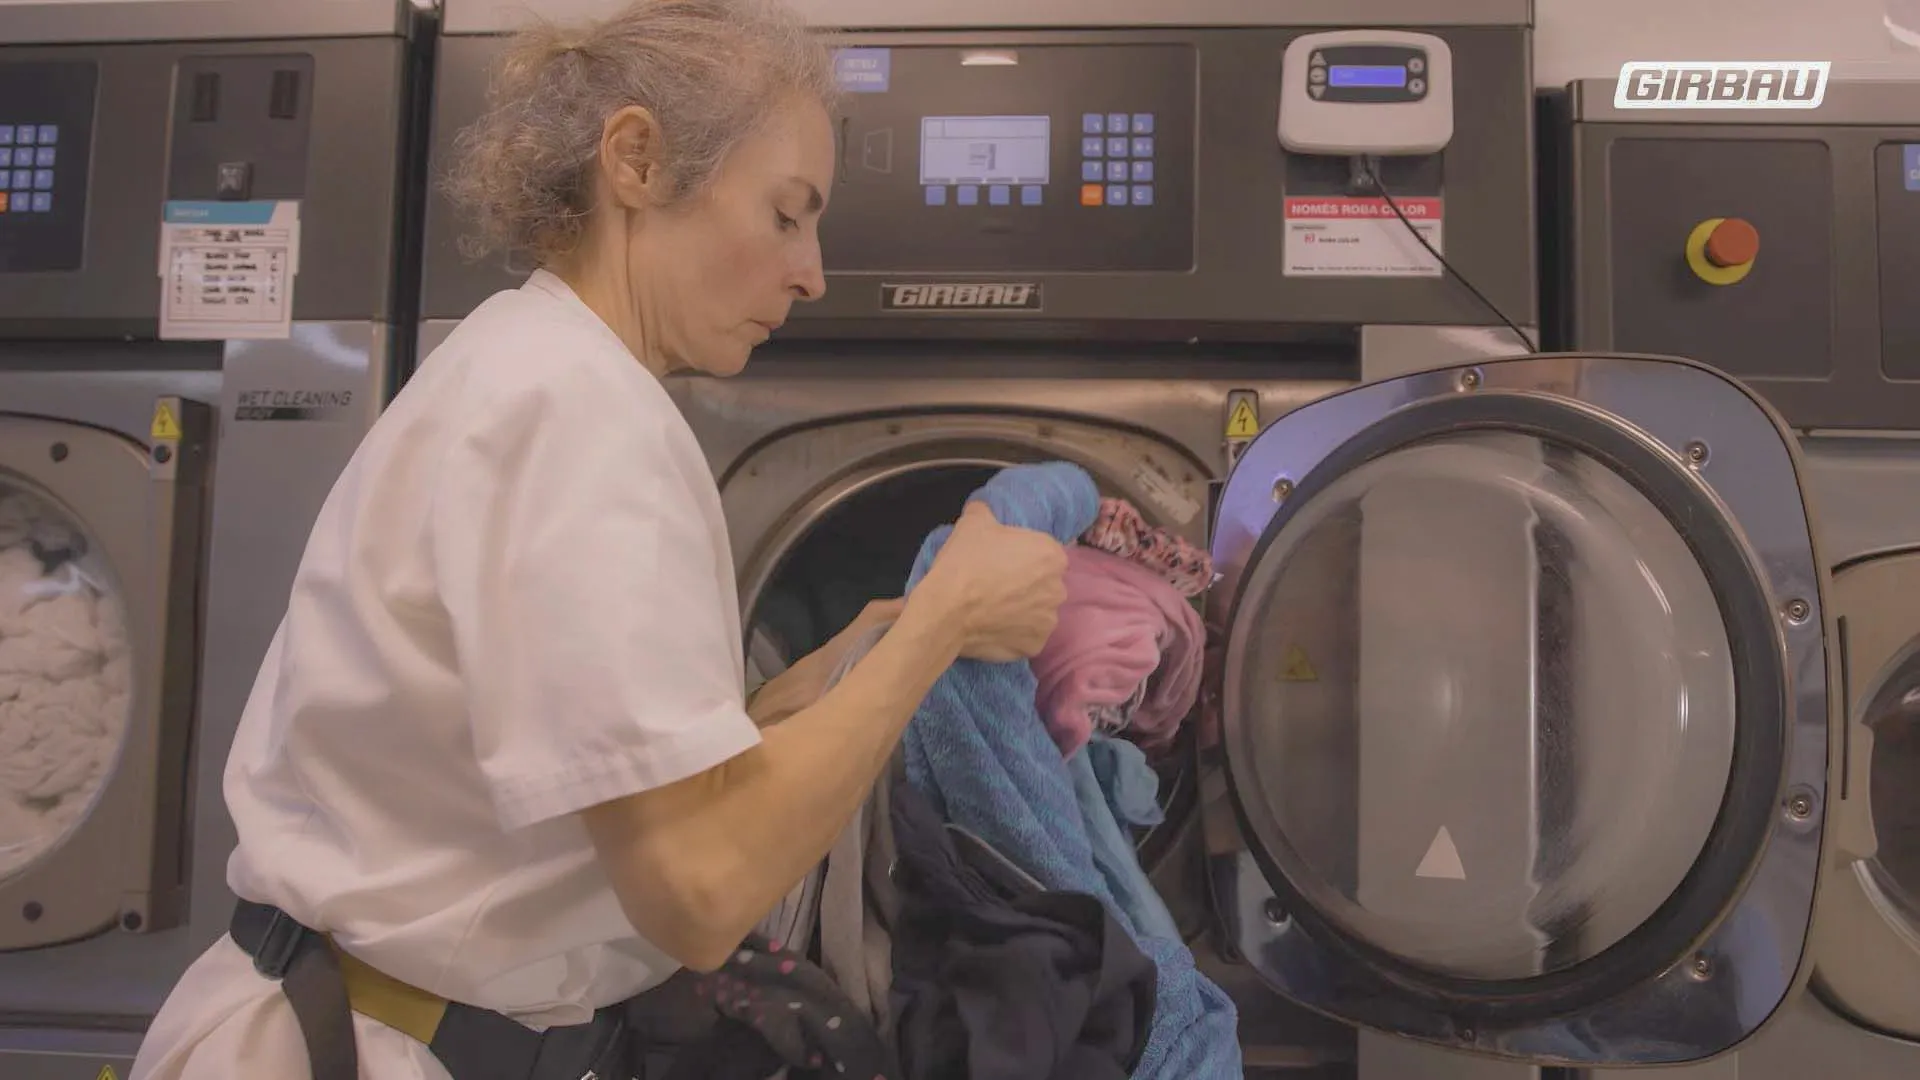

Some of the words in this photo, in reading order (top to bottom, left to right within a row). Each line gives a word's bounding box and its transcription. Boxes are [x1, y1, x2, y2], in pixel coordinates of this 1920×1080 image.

[1291, 203, 1339, 215] NOMÉS
[1341, 204, 1379, 215] ROBA
[893, 285, 1031, 307] GIRBAU
[238, 390, 272, 405] WET
[273, 390, 353, 406] CLEANING
